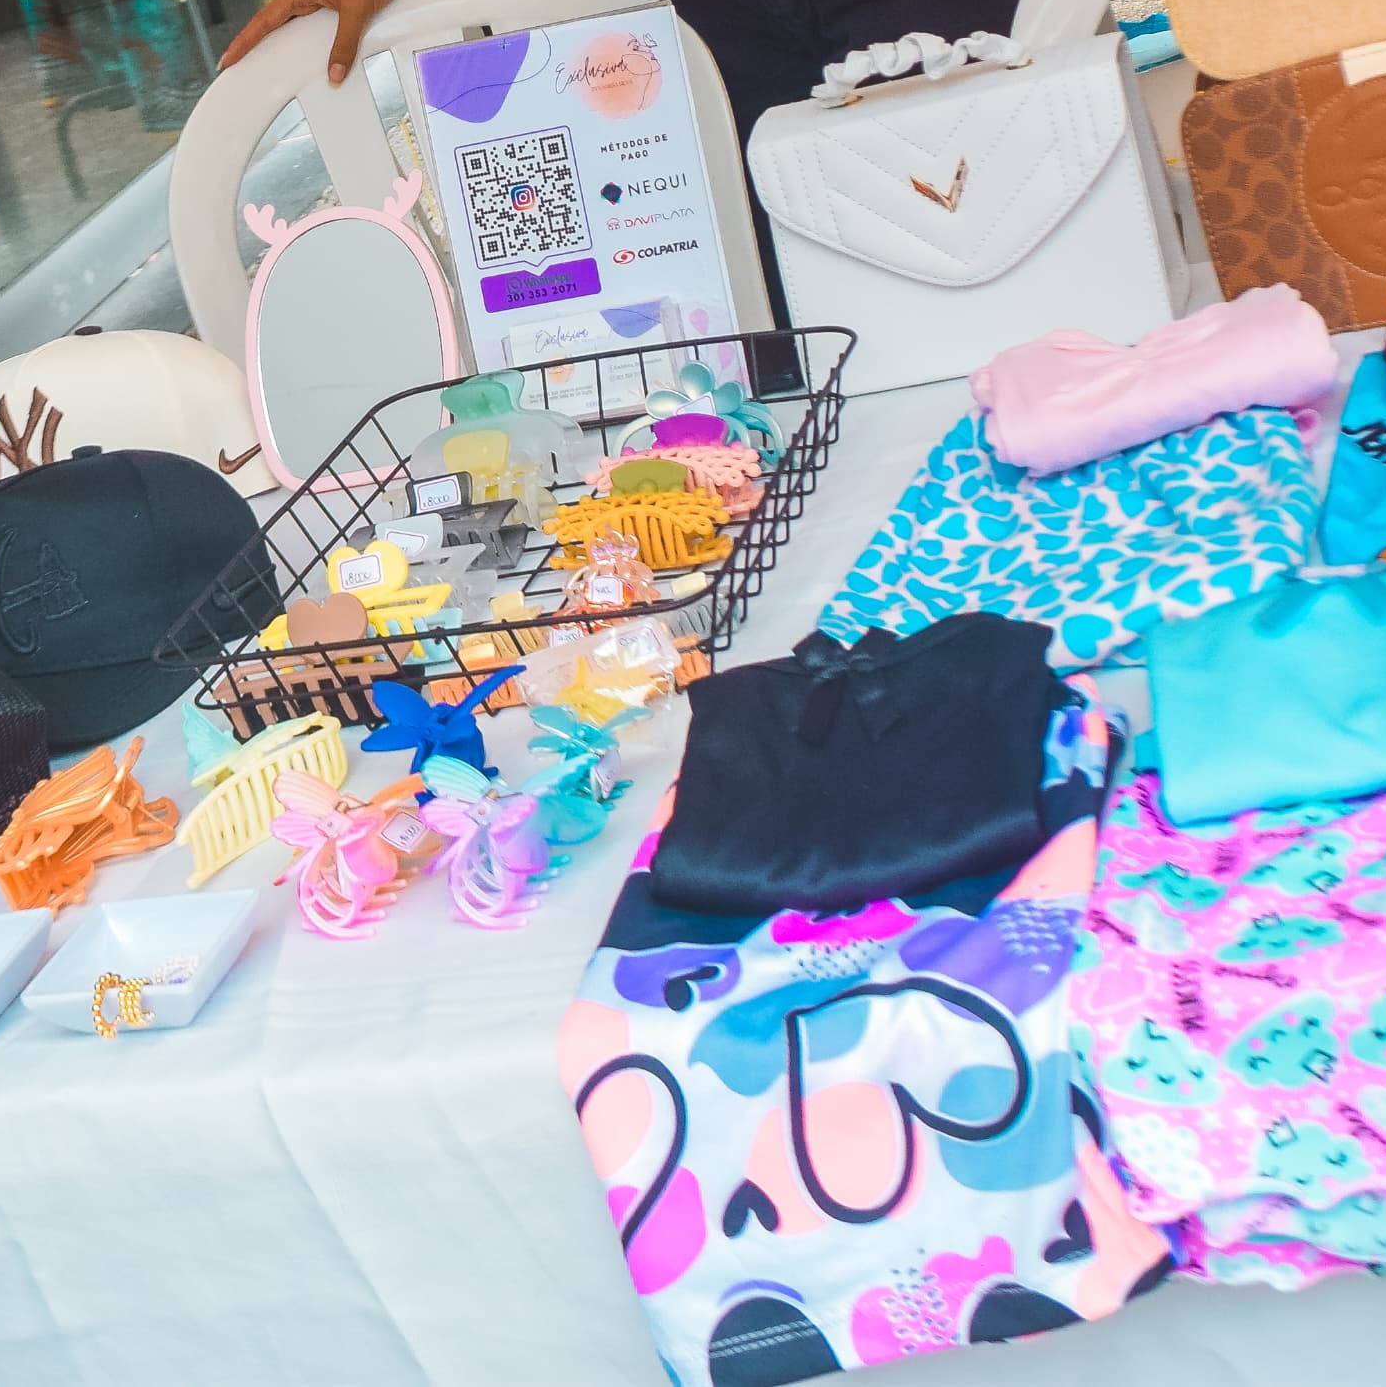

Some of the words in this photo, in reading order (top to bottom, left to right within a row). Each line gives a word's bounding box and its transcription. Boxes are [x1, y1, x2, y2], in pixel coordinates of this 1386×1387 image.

[600, 137, 650, 154] MÉTODOS
[654, 133, 669, 143] DE
[620, 150, 649, 161] PAGO
[628, 173, 688, 196] NEQUI
[624, 207, 695, 229] DAVIPLATA
[637, 239, 699, 259] COLPATRIA
[507, 293, 525, 303] 301
[528, 290, 548, 300] 353
[551, 283, 577, 295] 2071
